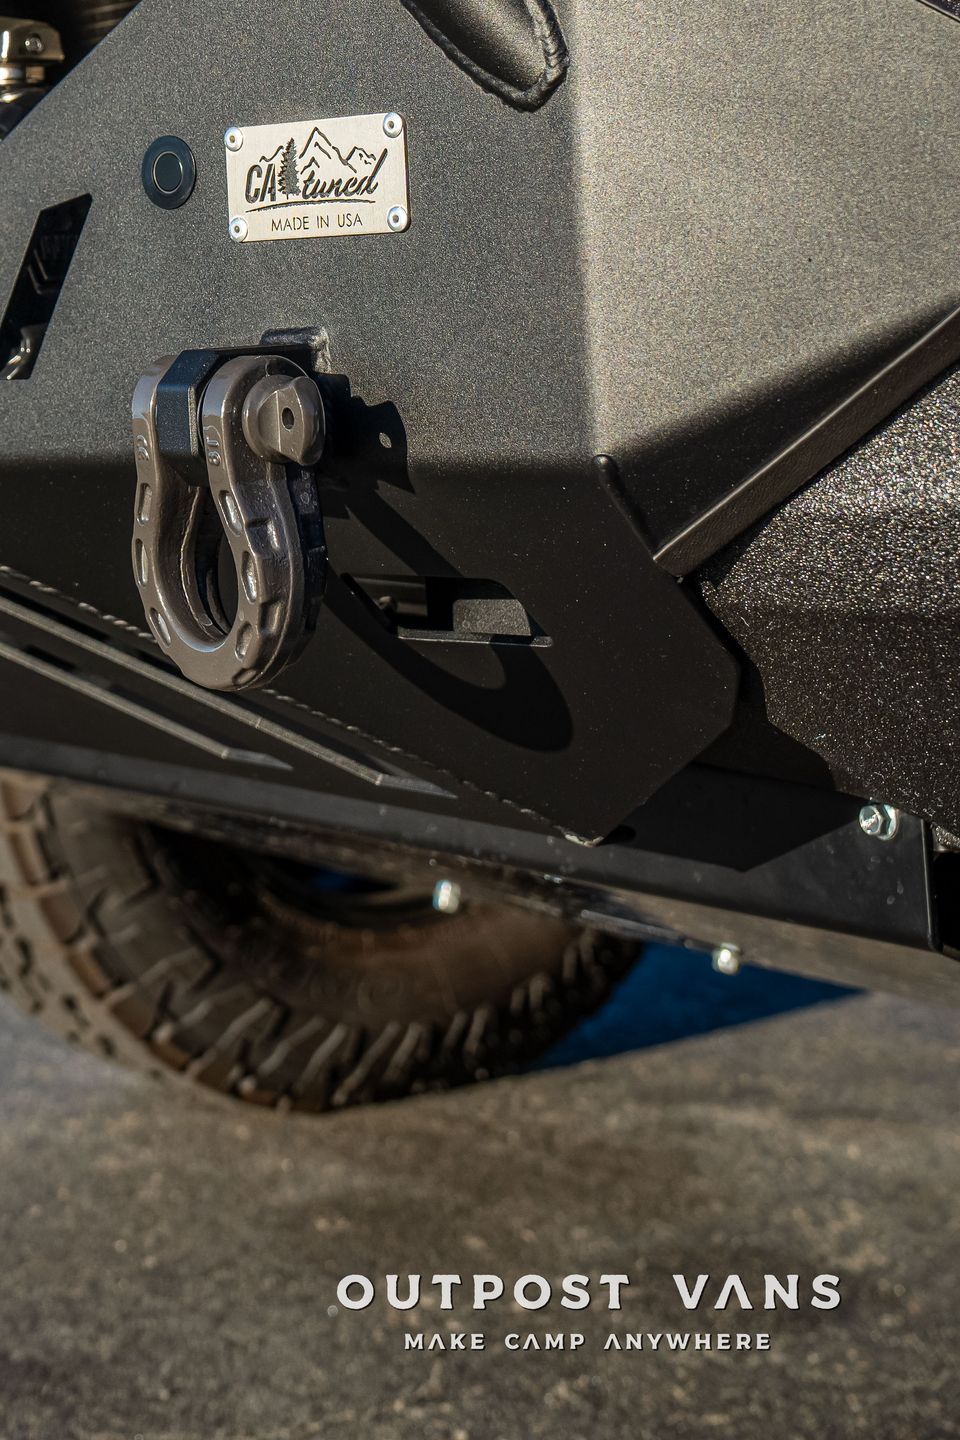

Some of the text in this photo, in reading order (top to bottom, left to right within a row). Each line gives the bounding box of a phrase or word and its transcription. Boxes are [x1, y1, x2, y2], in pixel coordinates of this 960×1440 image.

[271, 213, 363, 232] MADE IN USA
